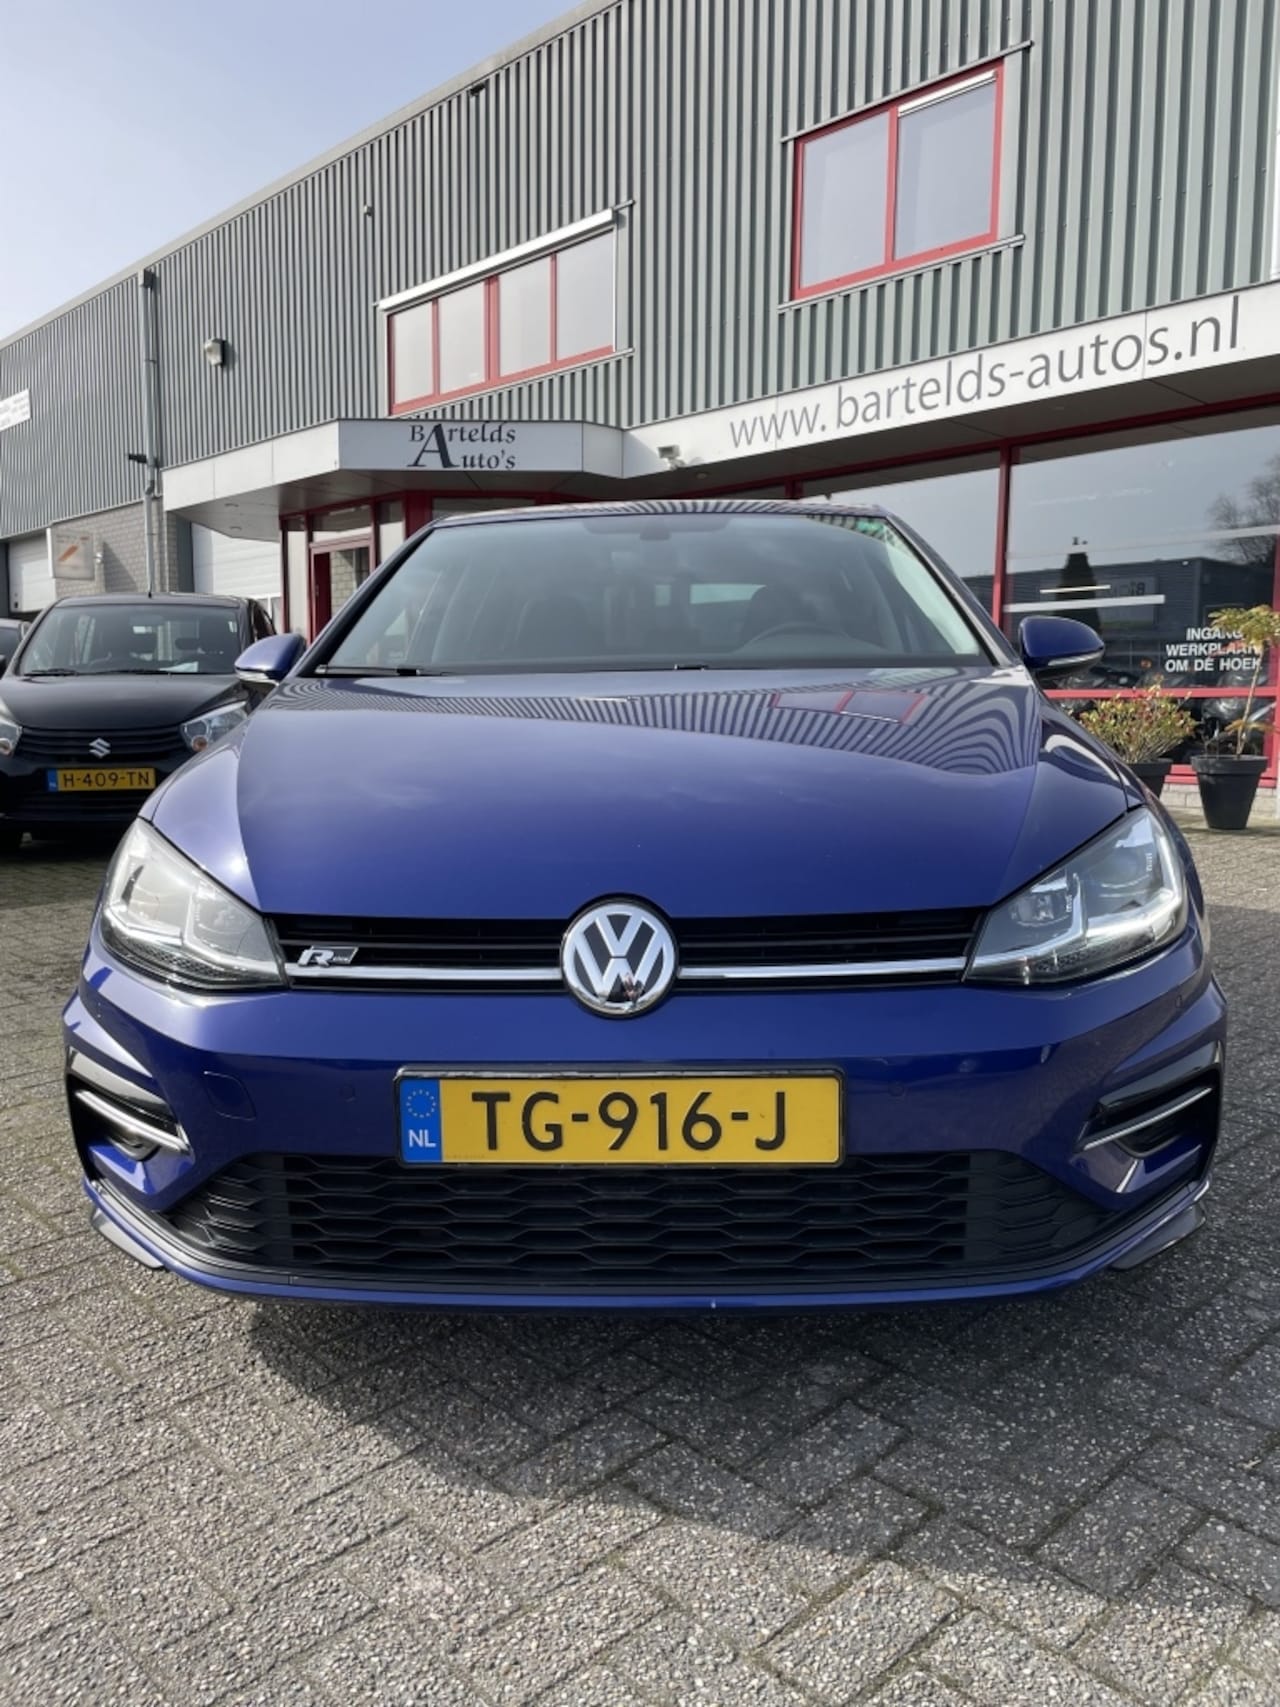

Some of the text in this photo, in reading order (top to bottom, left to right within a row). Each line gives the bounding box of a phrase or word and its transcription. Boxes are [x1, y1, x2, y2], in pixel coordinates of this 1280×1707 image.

[729, 294, 1240, 448] www.bartelds-autos.nl
[406, 423, 516, 469] Auto's
[1165, 657, 1262, 672] OM DE HOEK
[62, 771, 150, 788] H-409-TN
[565, 904, 673, 1010] VW
[408, 1129, 437, 1148] NL
[471, 1091, 786, 1152] TG-916-J
